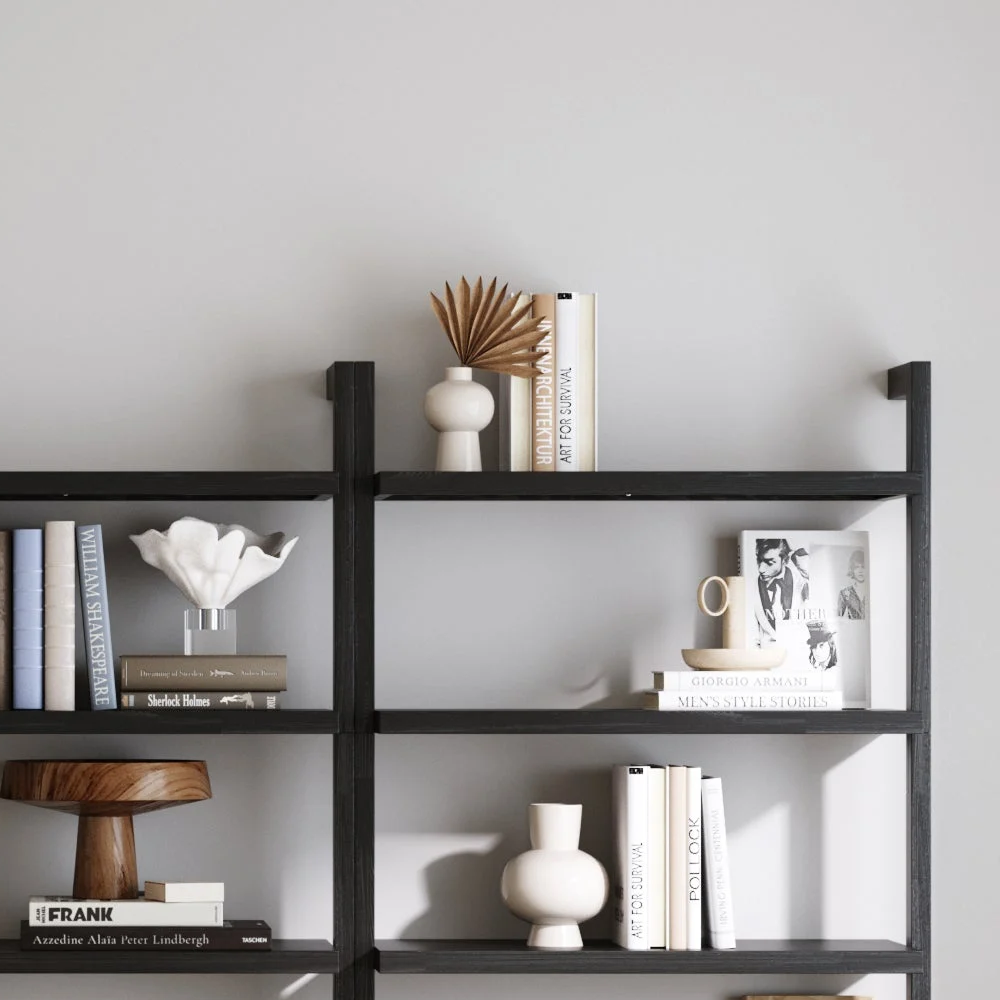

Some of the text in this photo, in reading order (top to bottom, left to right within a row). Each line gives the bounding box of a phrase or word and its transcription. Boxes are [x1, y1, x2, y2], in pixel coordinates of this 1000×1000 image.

[559, 367, 572, 464] ART FOR SURVIVAL
[80, 528, 110, 706] WILLIAM SHAKESPEARE
[691, 676, 808, 687] GIORGIO ARMANI
[147, 693, 211, 707] Sherlock Holmes
[677, 695, 829, 708] MEN'S STYLE STORIES
[631, 842, 643, 939] ART FOR SURVIVAL
[48, 906, 114, 922] FRANK
[32, 933, 210, 948] Azzedine Alaïa Peter Lindbergh
[242, 936, 268, 944] TASCHEN
